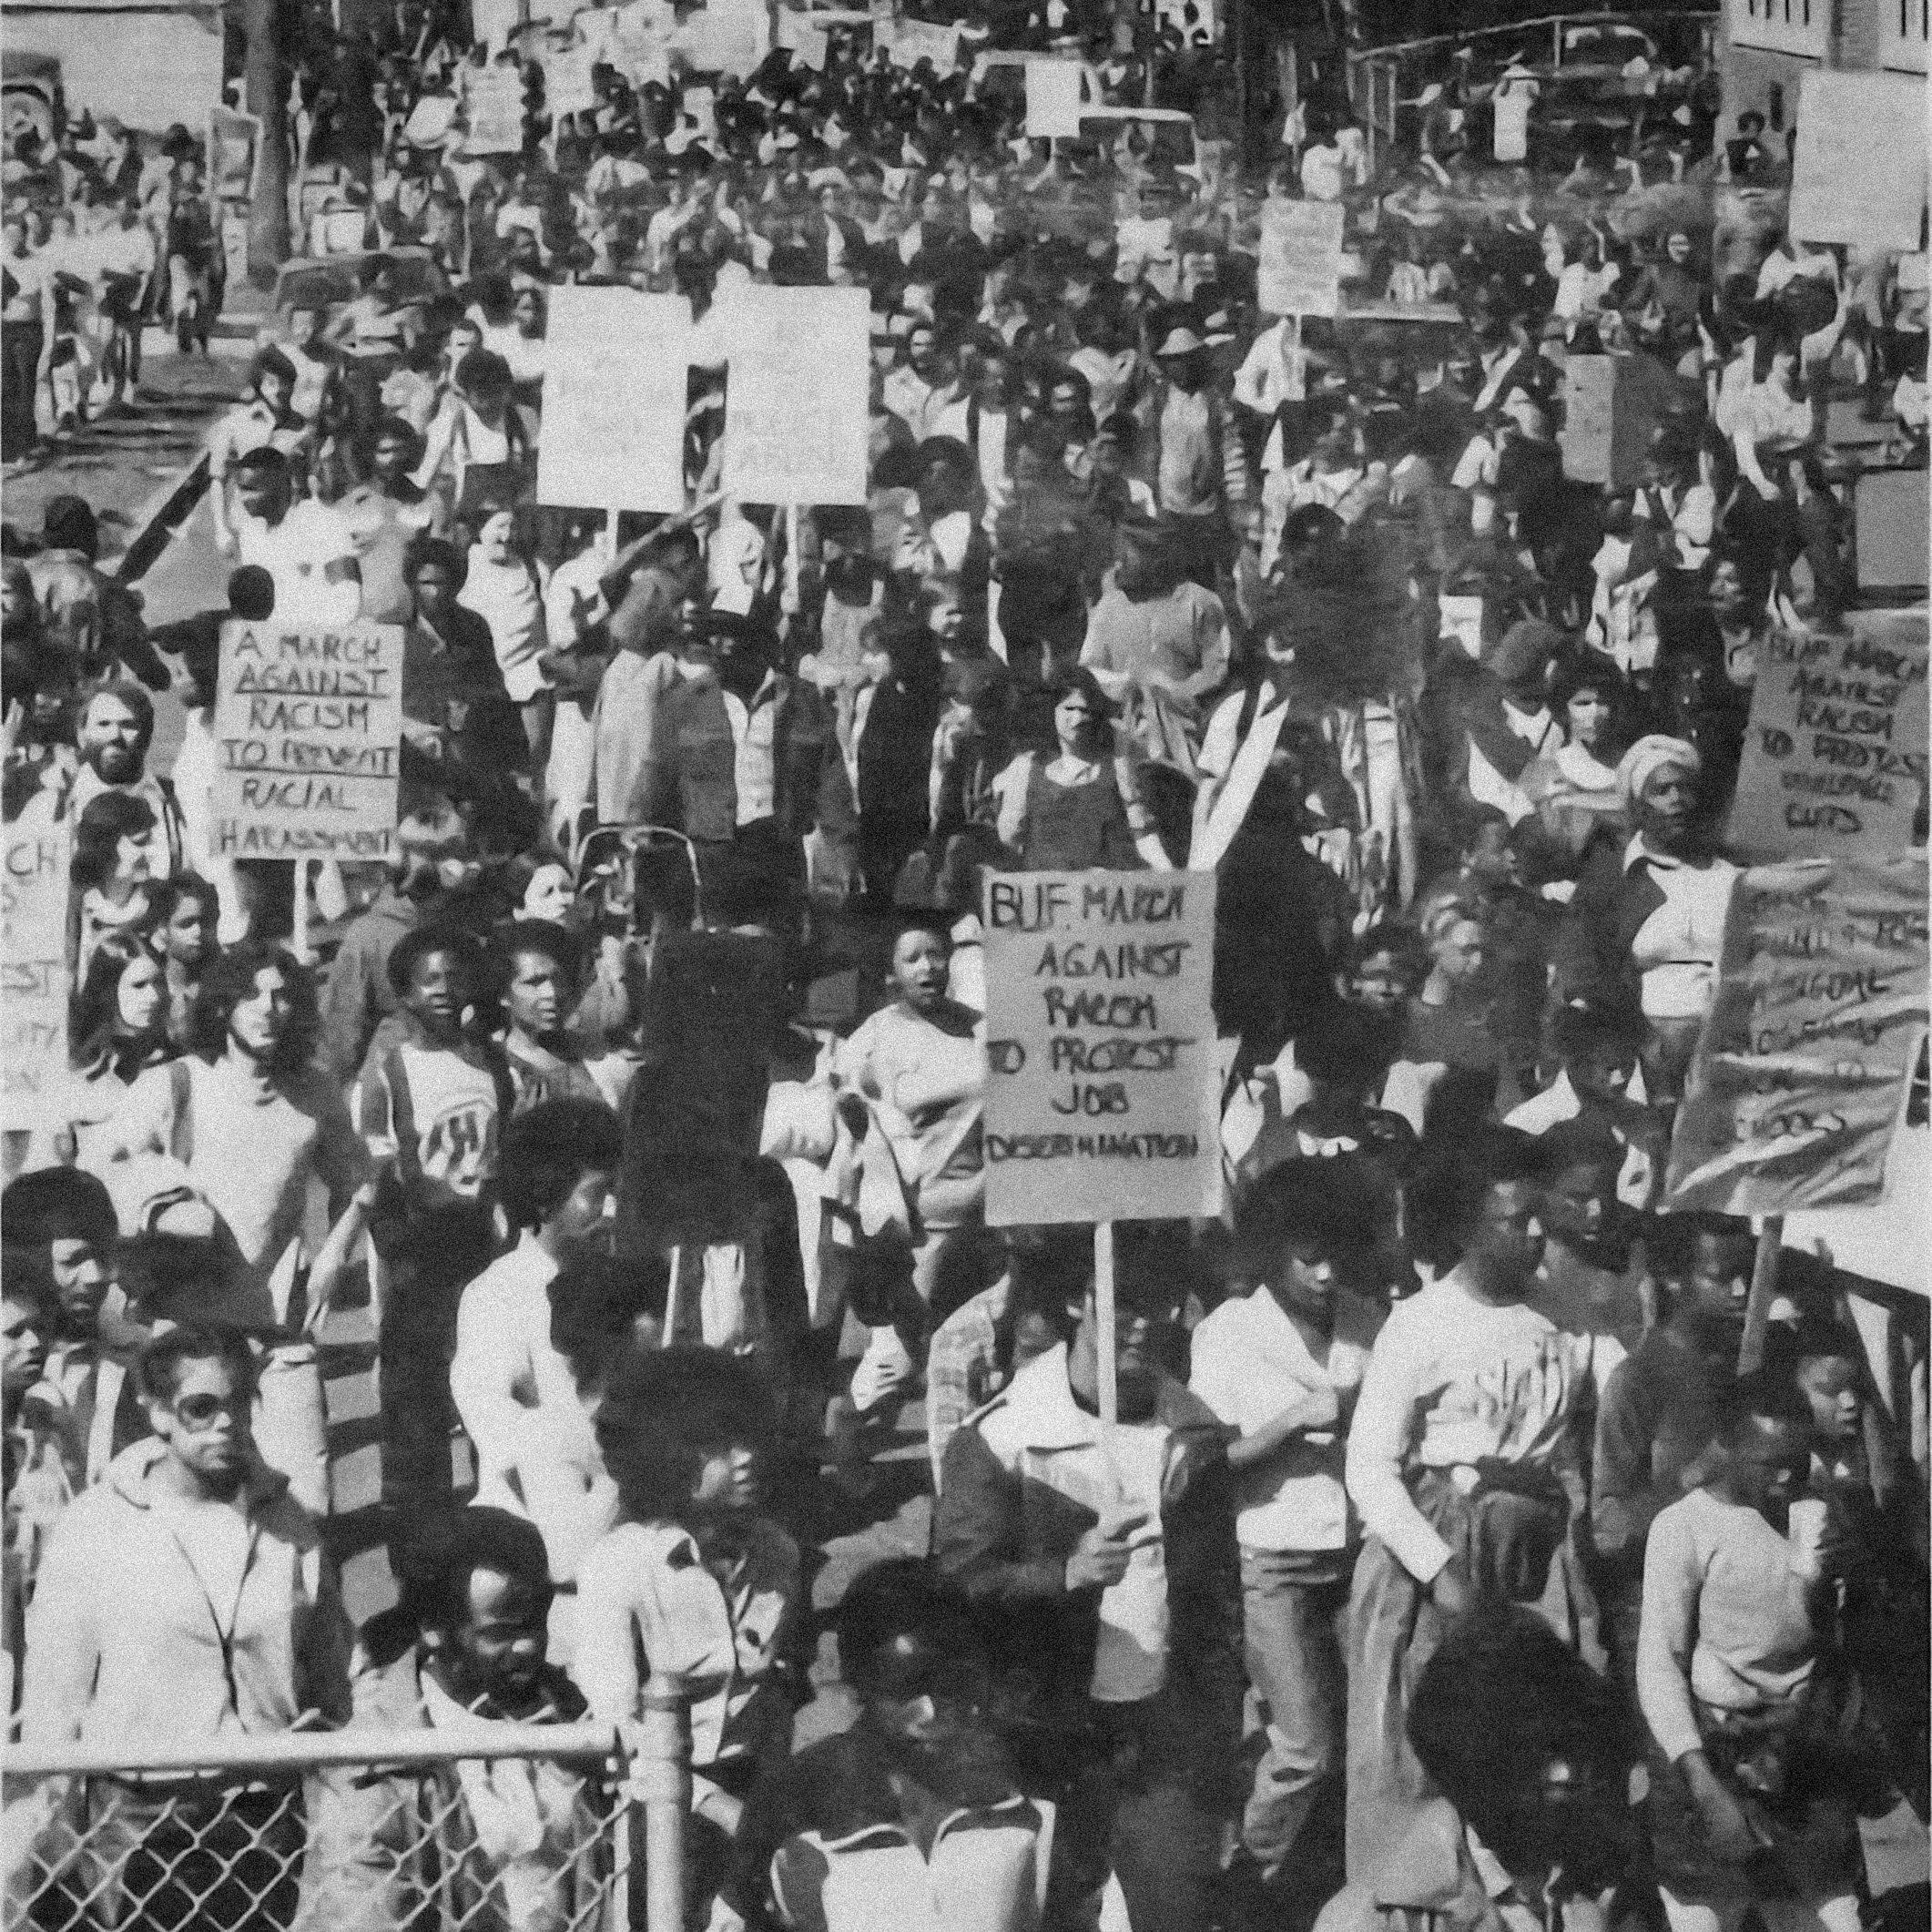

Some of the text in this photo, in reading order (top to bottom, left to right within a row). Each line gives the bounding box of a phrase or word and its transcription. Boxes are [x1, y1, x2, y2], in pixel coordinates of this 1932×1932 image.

[234, 630, 381, 663] A MARCH
[235, 664, 388, 695] AGAINST
[249, 696, 369, 734] RACISM
[221, 738, 267, 765] TO
[242, 778, 357, 810] RACIAL
[1083, 884, 1186, 924] MARCH
[1034, 941, 1190, 979] AGAINST
[1043, 986, 1156, 1030] RACISM
[987, 1035, 1198, 1074] TO PROTEST
[1050, 1083, 1130, 1116] JOB
